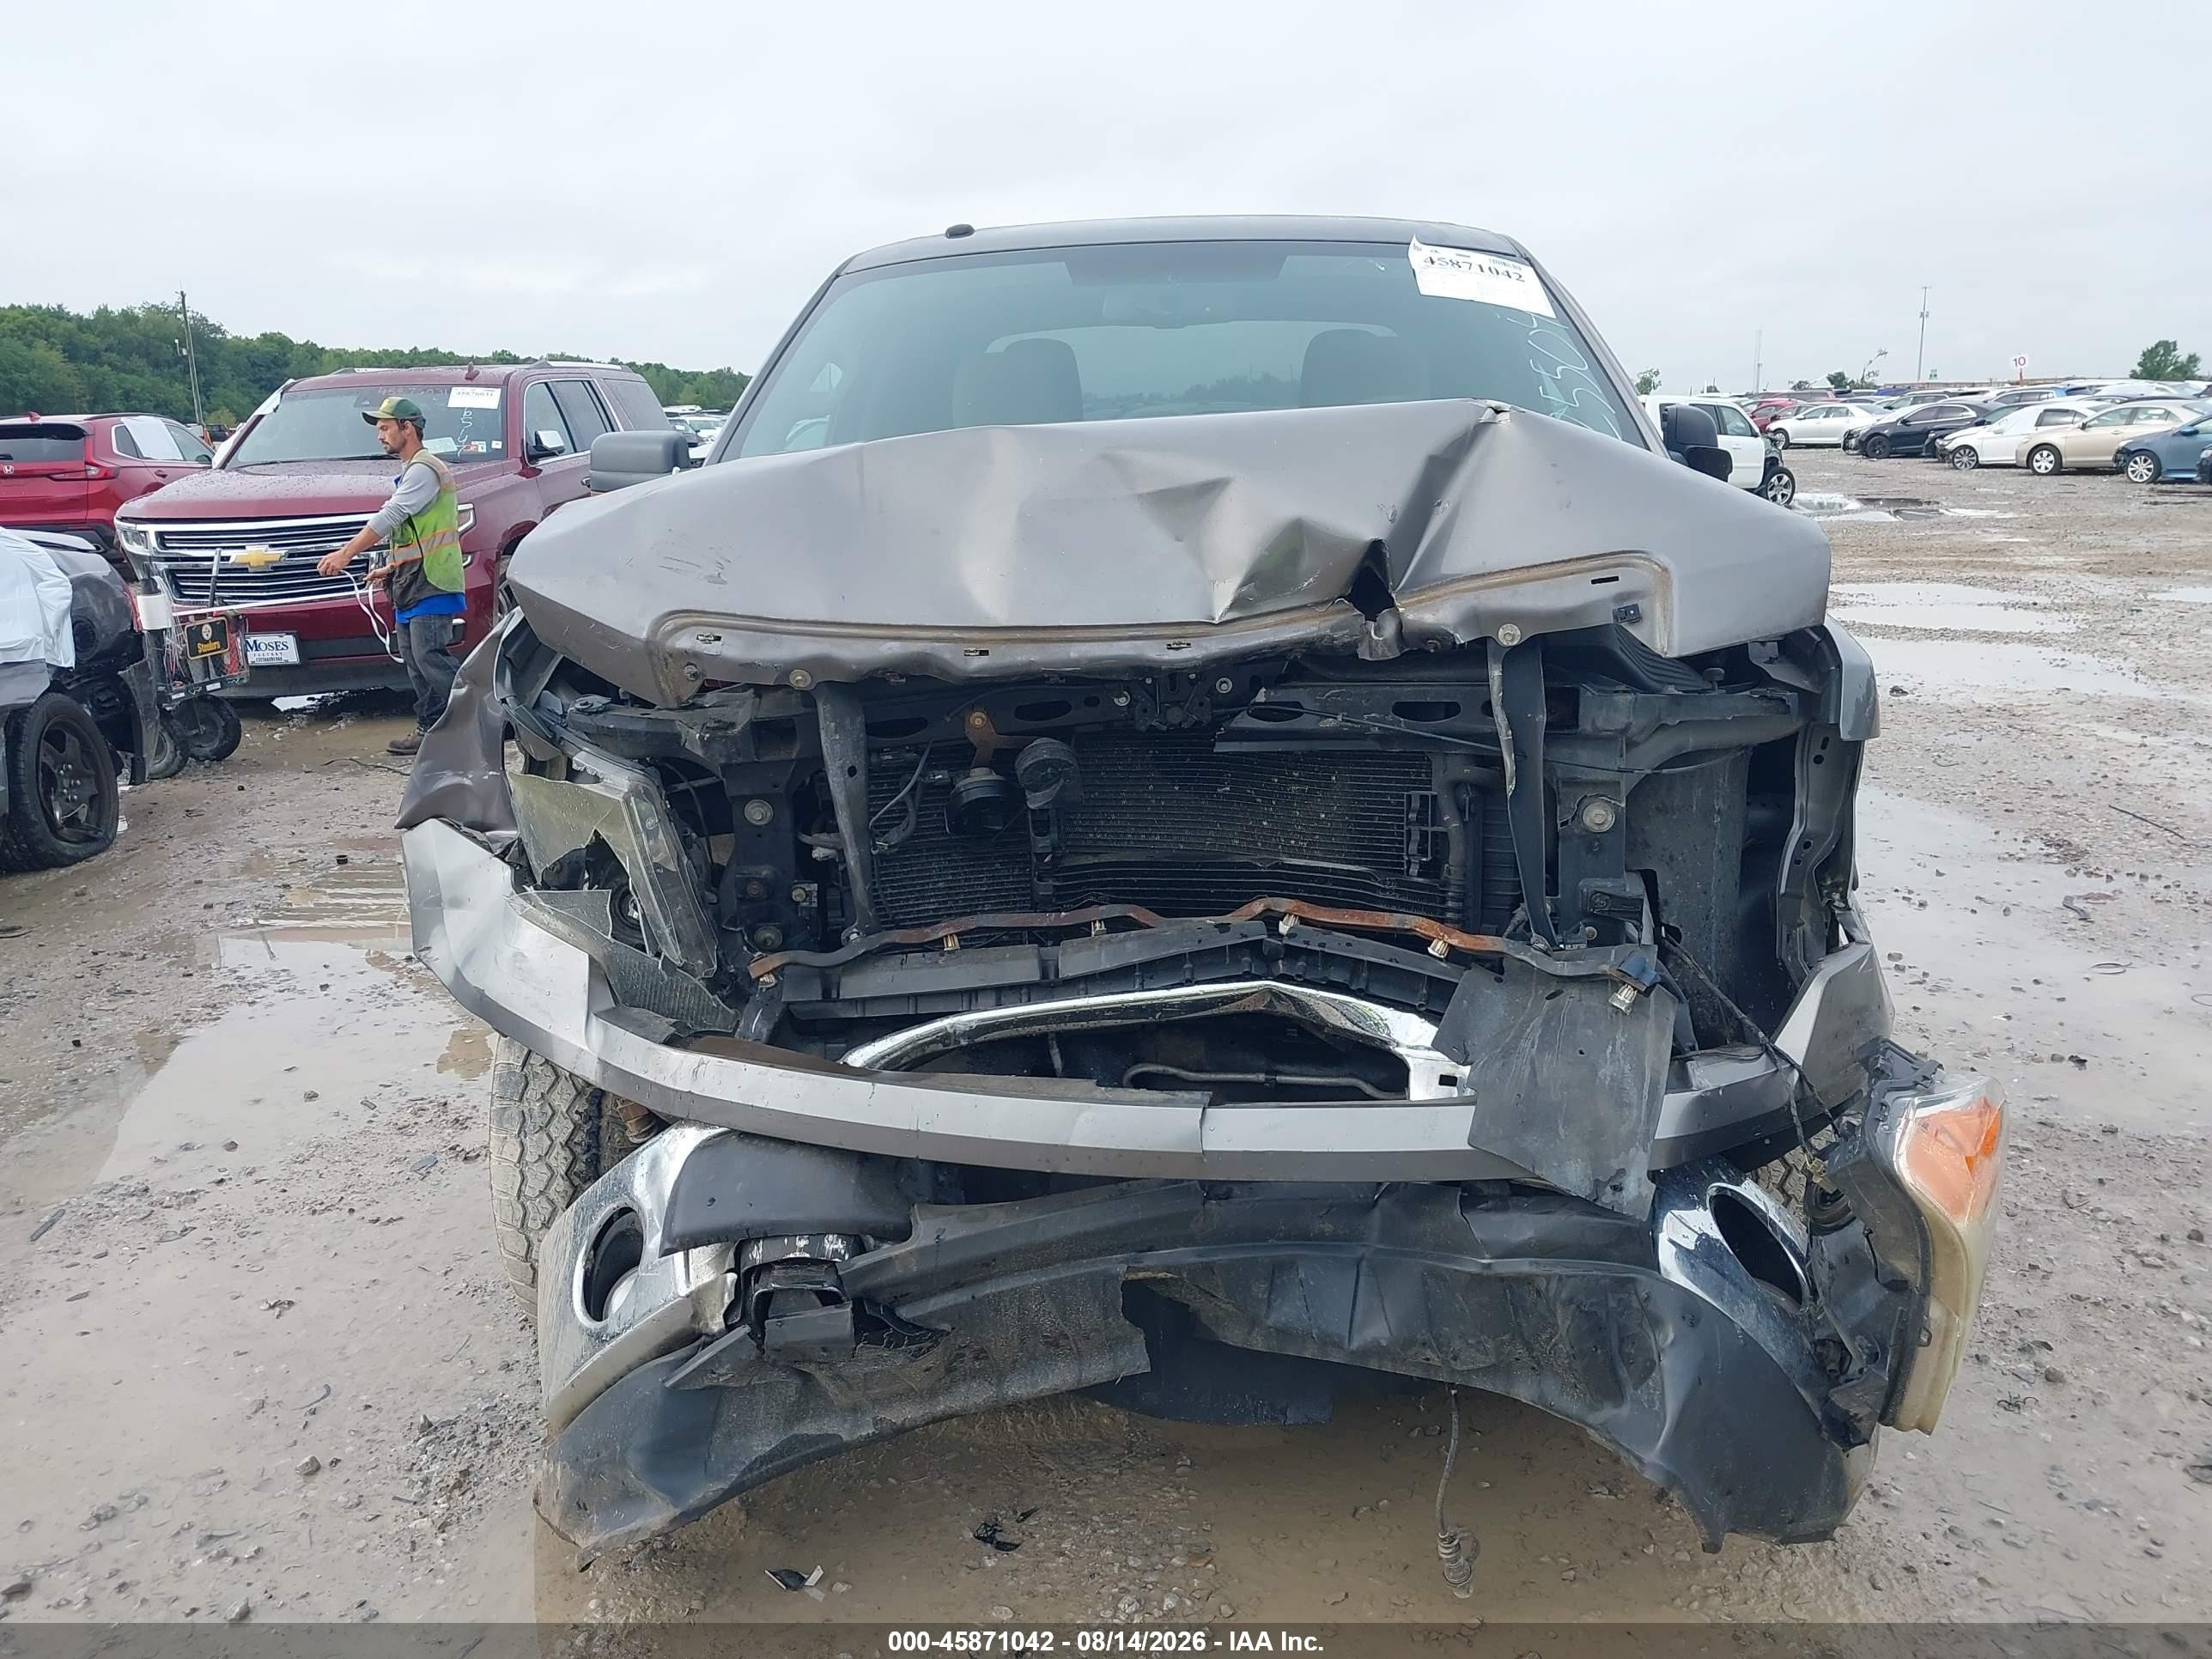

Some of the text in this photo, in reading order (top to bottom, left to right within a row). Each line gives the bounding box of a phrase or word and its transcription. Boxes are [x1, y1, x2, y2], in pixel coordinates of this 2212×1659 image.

[1424, 255, 1525, 283] 45871042
[2013, 356, 2026, 368] 10
[198, 640, 221, 653] Steelers
